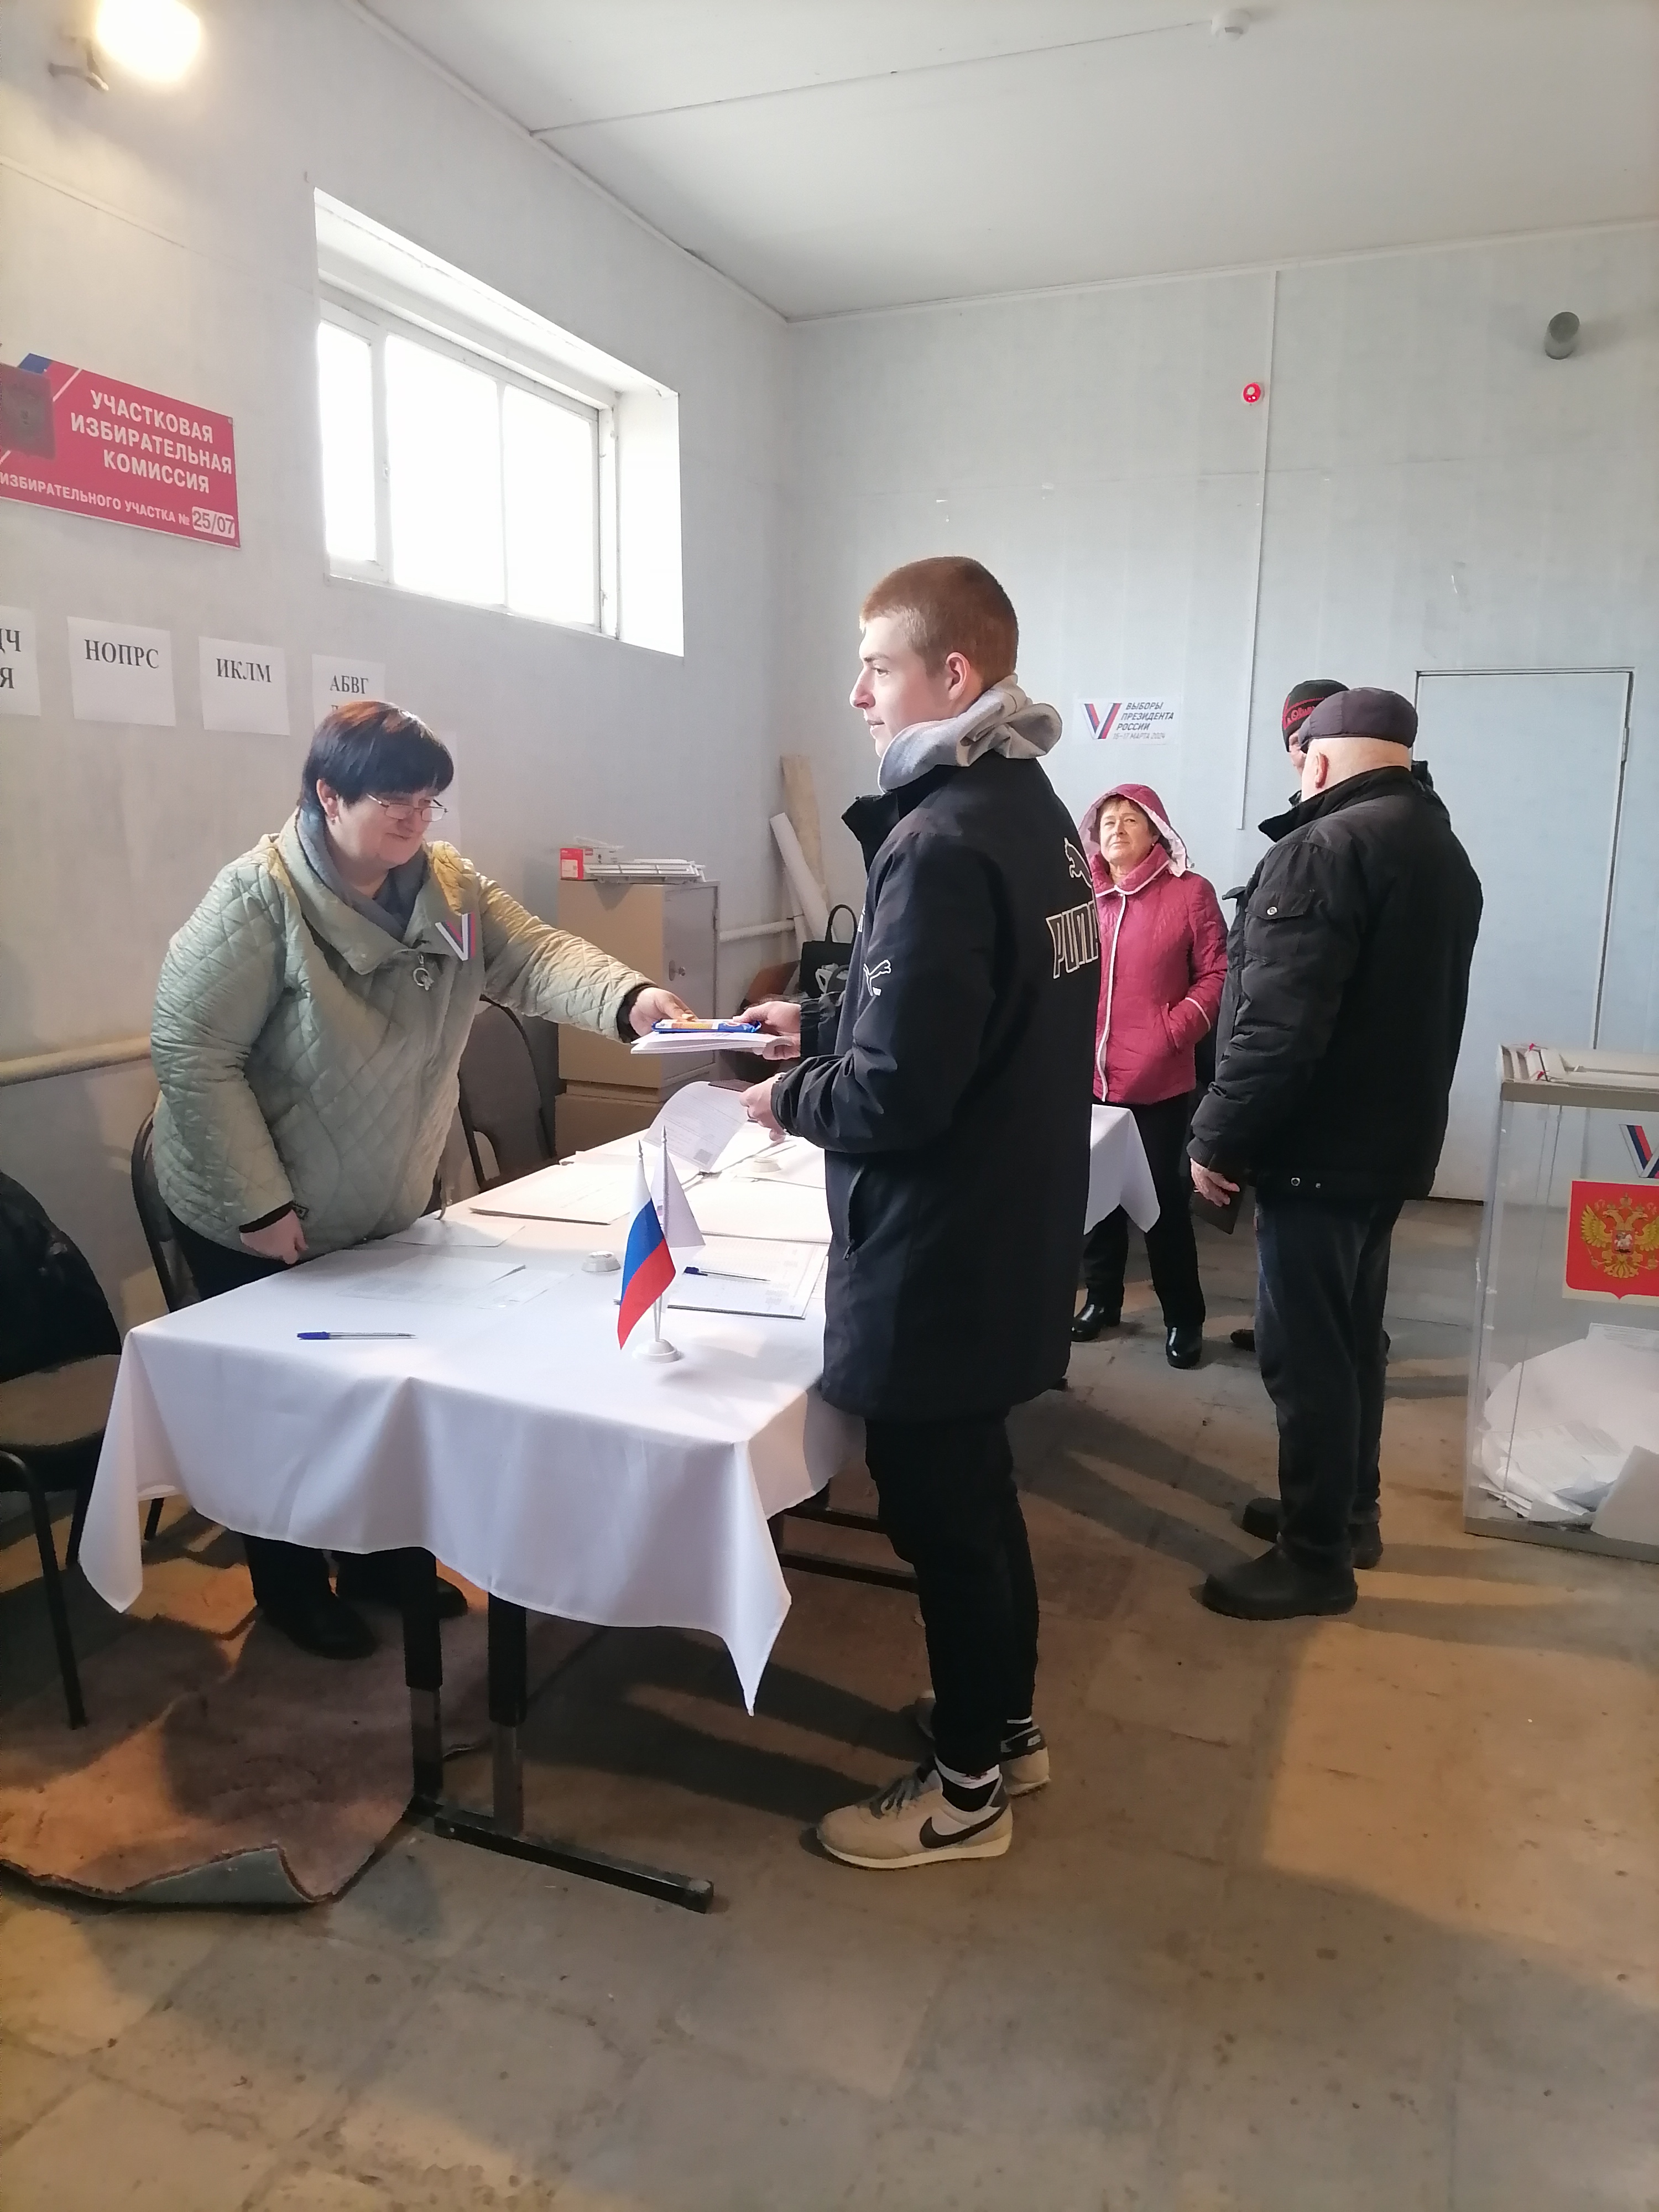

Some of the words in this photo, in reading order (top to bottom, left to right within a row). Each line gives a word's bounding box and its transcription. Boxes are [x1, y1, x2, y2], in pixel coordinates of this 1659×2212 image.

[90, 389, 213, 444] УЧАСТКОВАЯ
[71, 413, 232, 474] ИЗБИРАТЕЛЬНАЯ
[104, 450, 210, 493] КОМИССИЯ
[0, 471, 121, 510] ИЗБИРАТЕЛЬНОГО
[125, 500, 175, 523] УЧАСТКА
[178, 513, 190, 525] №
[193, 510, 234, 534] 25/07
[84, 639, 159, 669] НОПРС
[0, 667, 14, 689] Я
[216, 658, 272, 683] ИКЛМ
[330, 675, 369, 694] АБВГ
[1120, 712, 1174, 721] ПРЕЗИДЕНТА
[1125, 702, 1164, 710] ВЫБОРЫ
